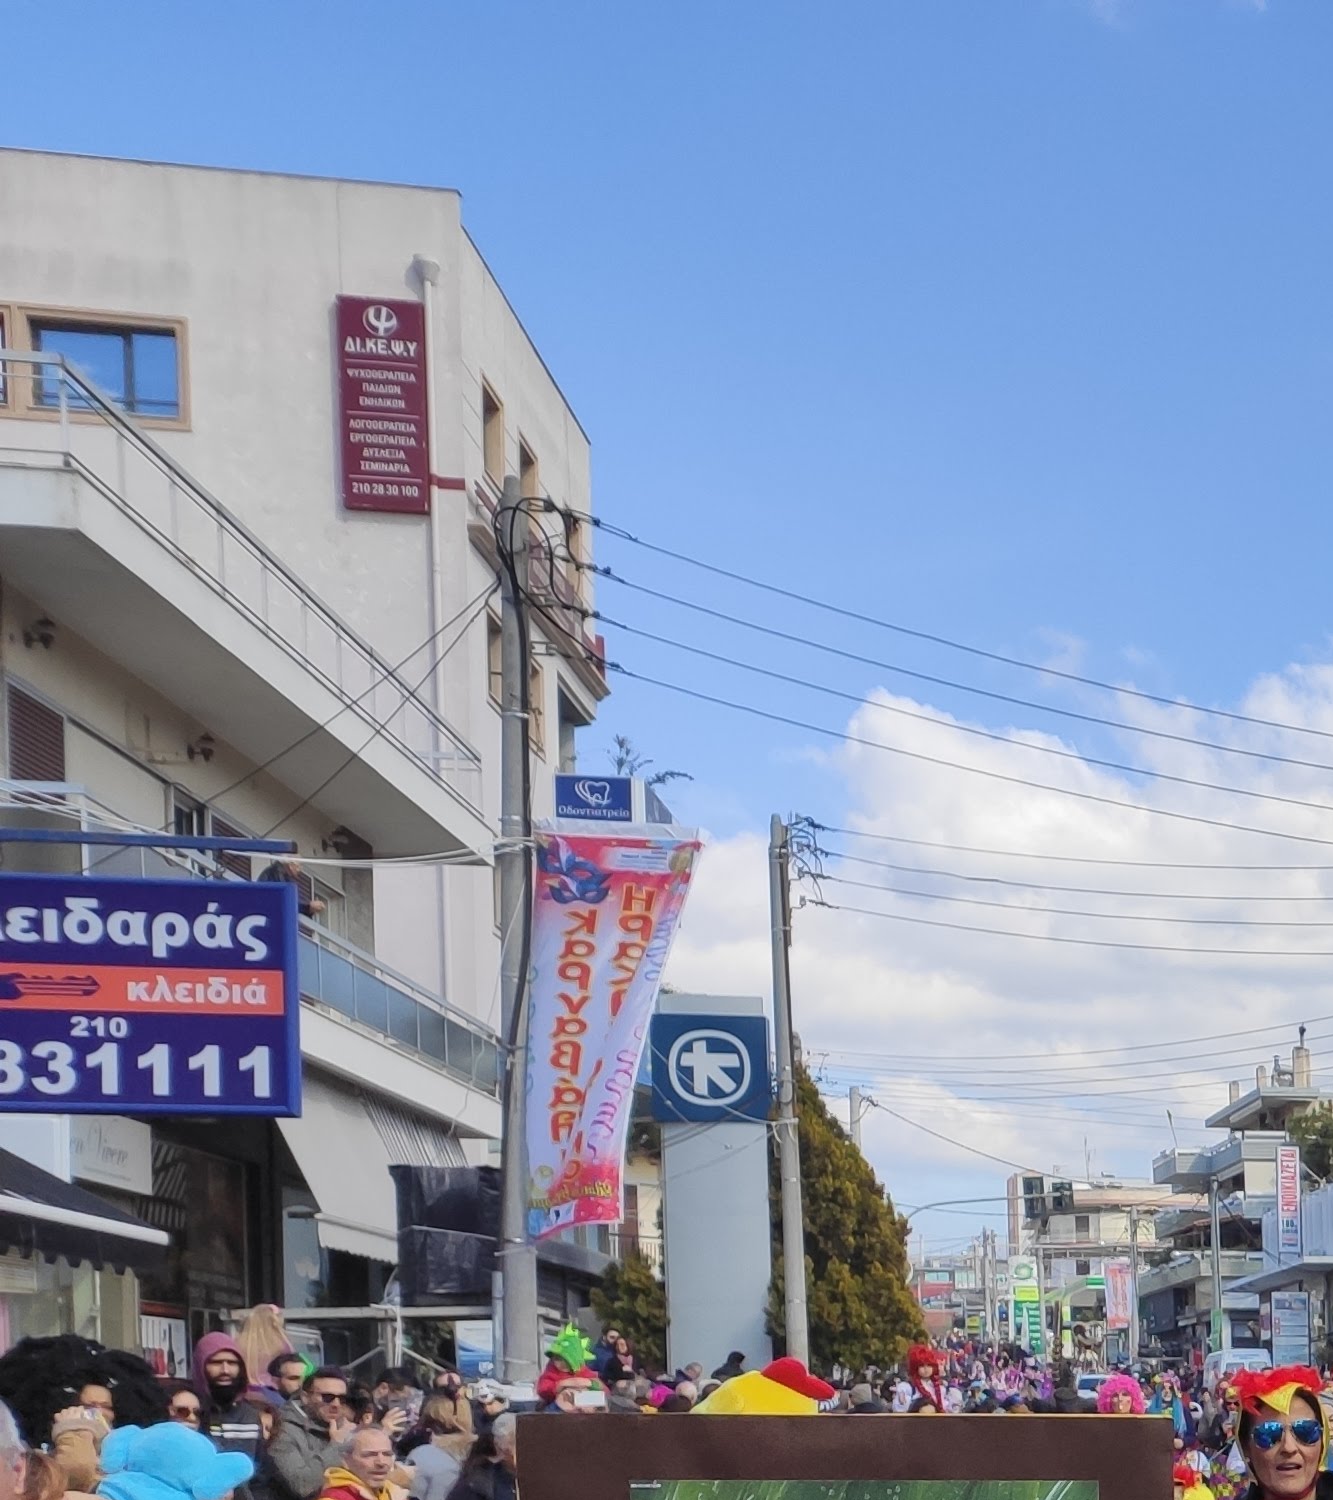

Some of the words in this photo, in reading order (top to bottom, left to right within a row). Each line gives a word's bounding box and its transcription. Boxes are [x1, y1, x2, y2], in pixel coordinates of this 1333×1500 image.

[346, 367, 417, 383] ΨΥΧΟΘΕΡΑΠΕΙΑ
[348, 418, 417, 433] ΛΟΓΟΘΕΡΑΠΕΙΑ
[349, 431, 417, 447] ΕΡΓΟΘΕΡΑΠΕΙΑ
[359, 460, 411, 473] ΣΕΜΙΝΑΡΙΑ
[351, 481, 371, 494] 210
[372, 483, 385, 495] 28
[386, 484, 400, 496] 30
[401, 485, 419, 497] 100
[0, 896, 268, 962] ειδαράς
[127, 975, 267, 1005] κλειδιά
[70, 1016, 128, 1038] 210
